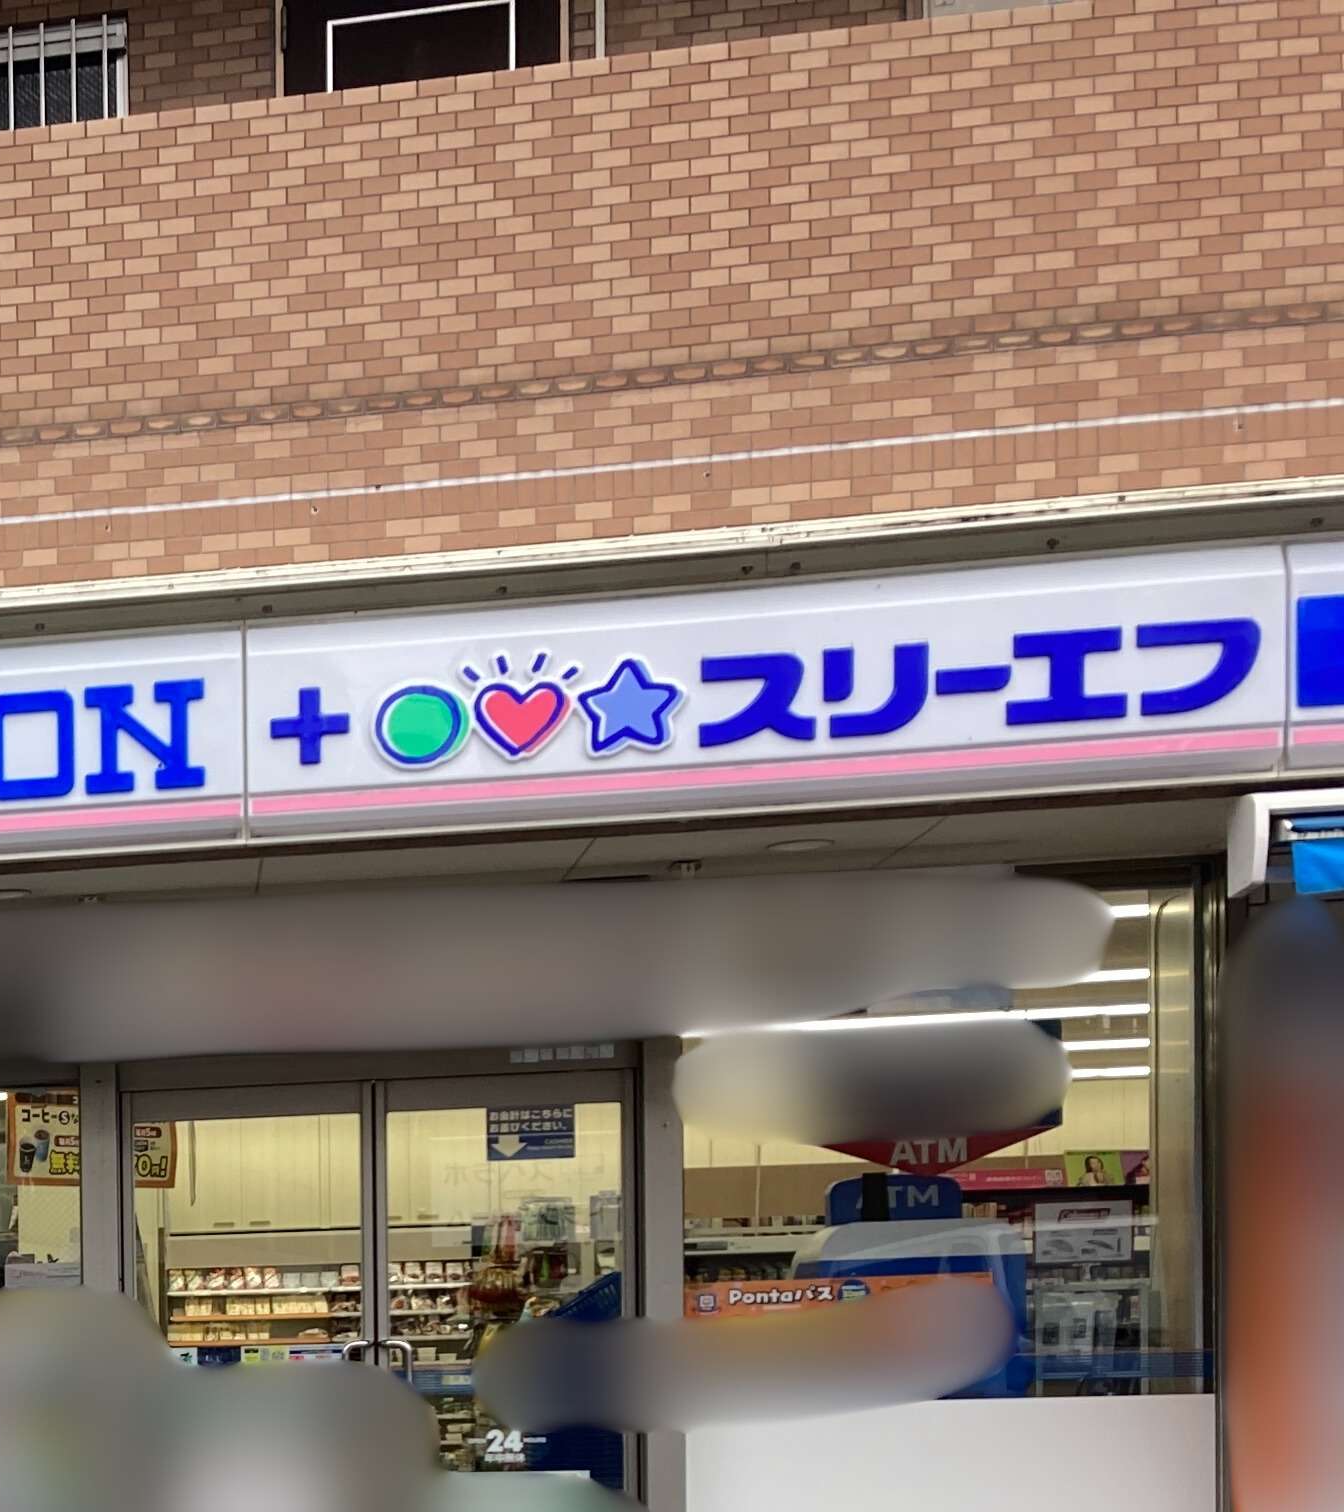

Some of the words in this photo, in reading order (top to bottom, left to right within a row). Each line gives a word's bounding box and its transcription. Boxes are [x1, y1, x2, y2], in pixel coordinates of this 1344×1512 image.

[698, 618, 1263, 748] スリーエフ
[489, 1108, 573, 1121] お会計はこちらに
[890, 1136, 968, 1166] ATM
[855, 1184, 940, 1208] TM
